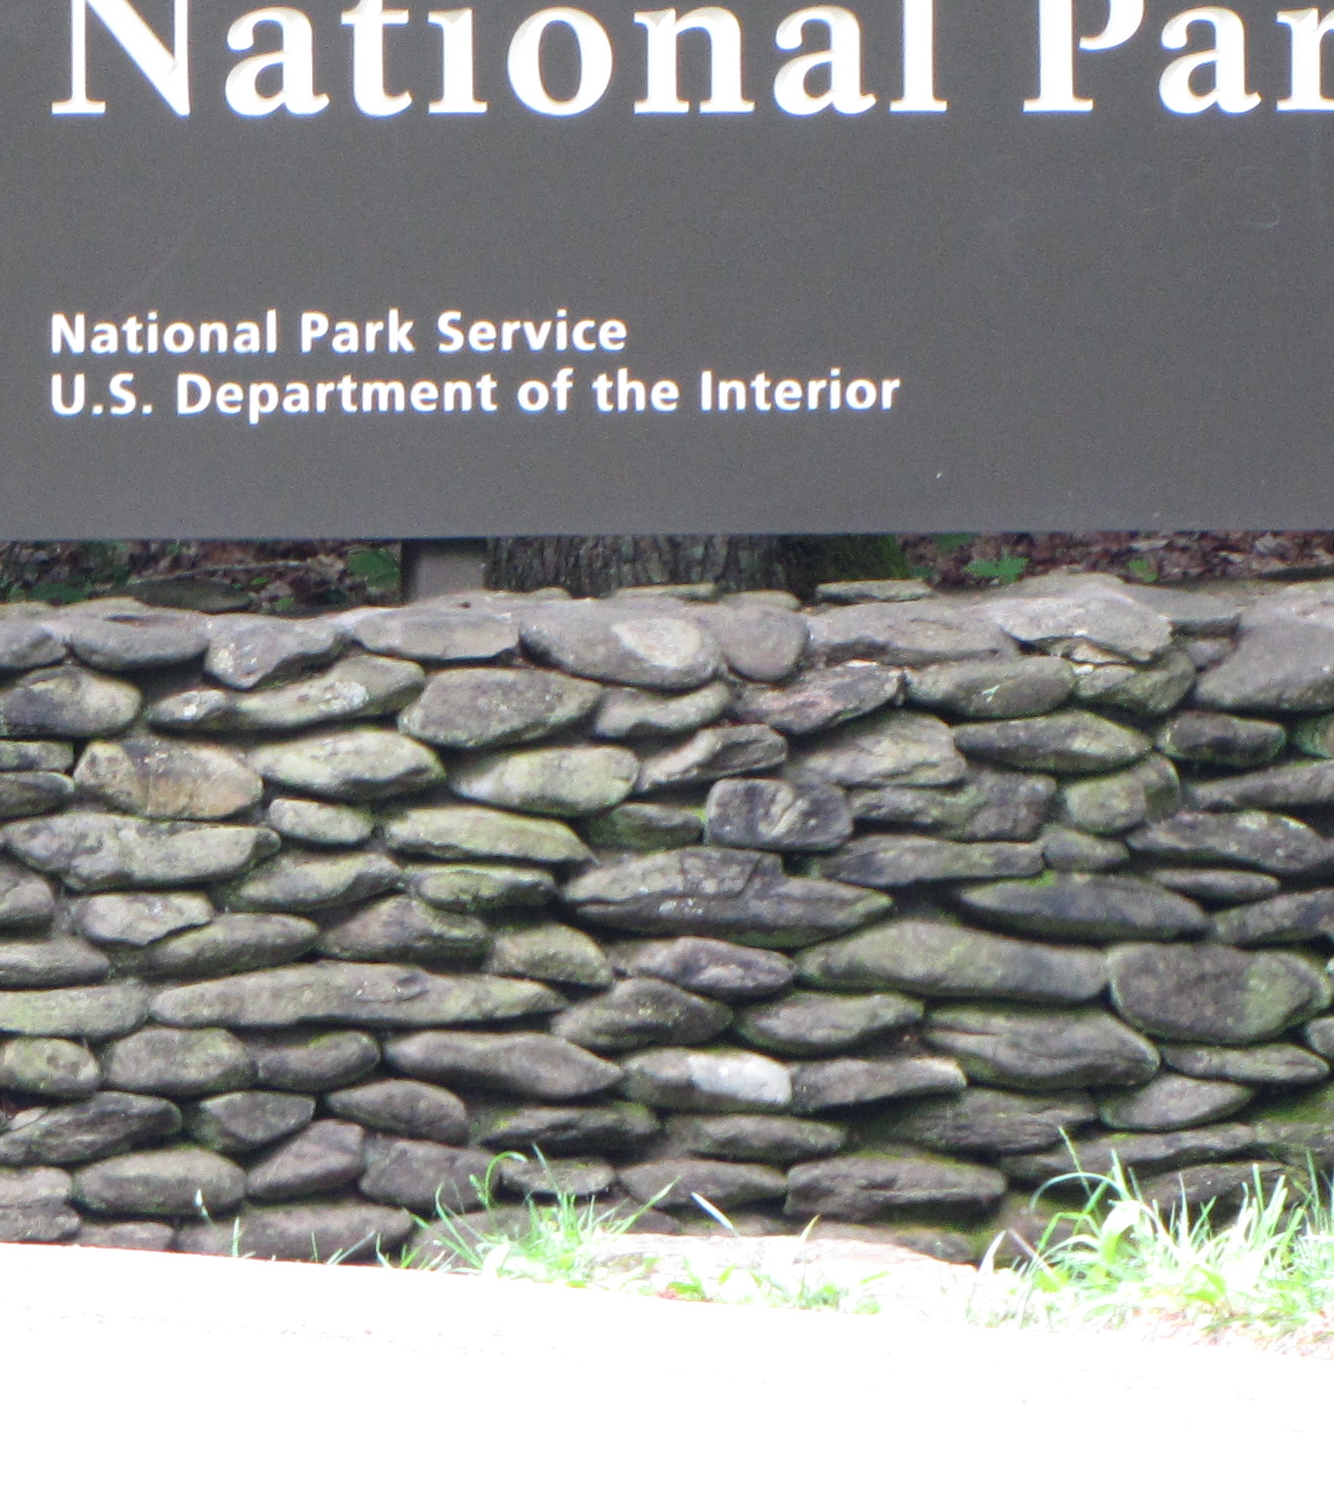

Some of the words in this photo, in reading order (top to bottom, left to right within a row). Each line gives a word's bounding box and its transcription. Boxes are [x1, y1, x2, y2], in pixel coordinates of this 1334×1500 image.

[49, 308, 278, 355] National
[300, 308, 416, 353] Park
[436, 308, 628, 353] Service
[49, 372, 154, 417] U.S.
[176, 373, 498, 426] Department
[516, 367, 575, 413] of
[591, 367, 680, 412] the
[700, 367, 902, 411] Interior
